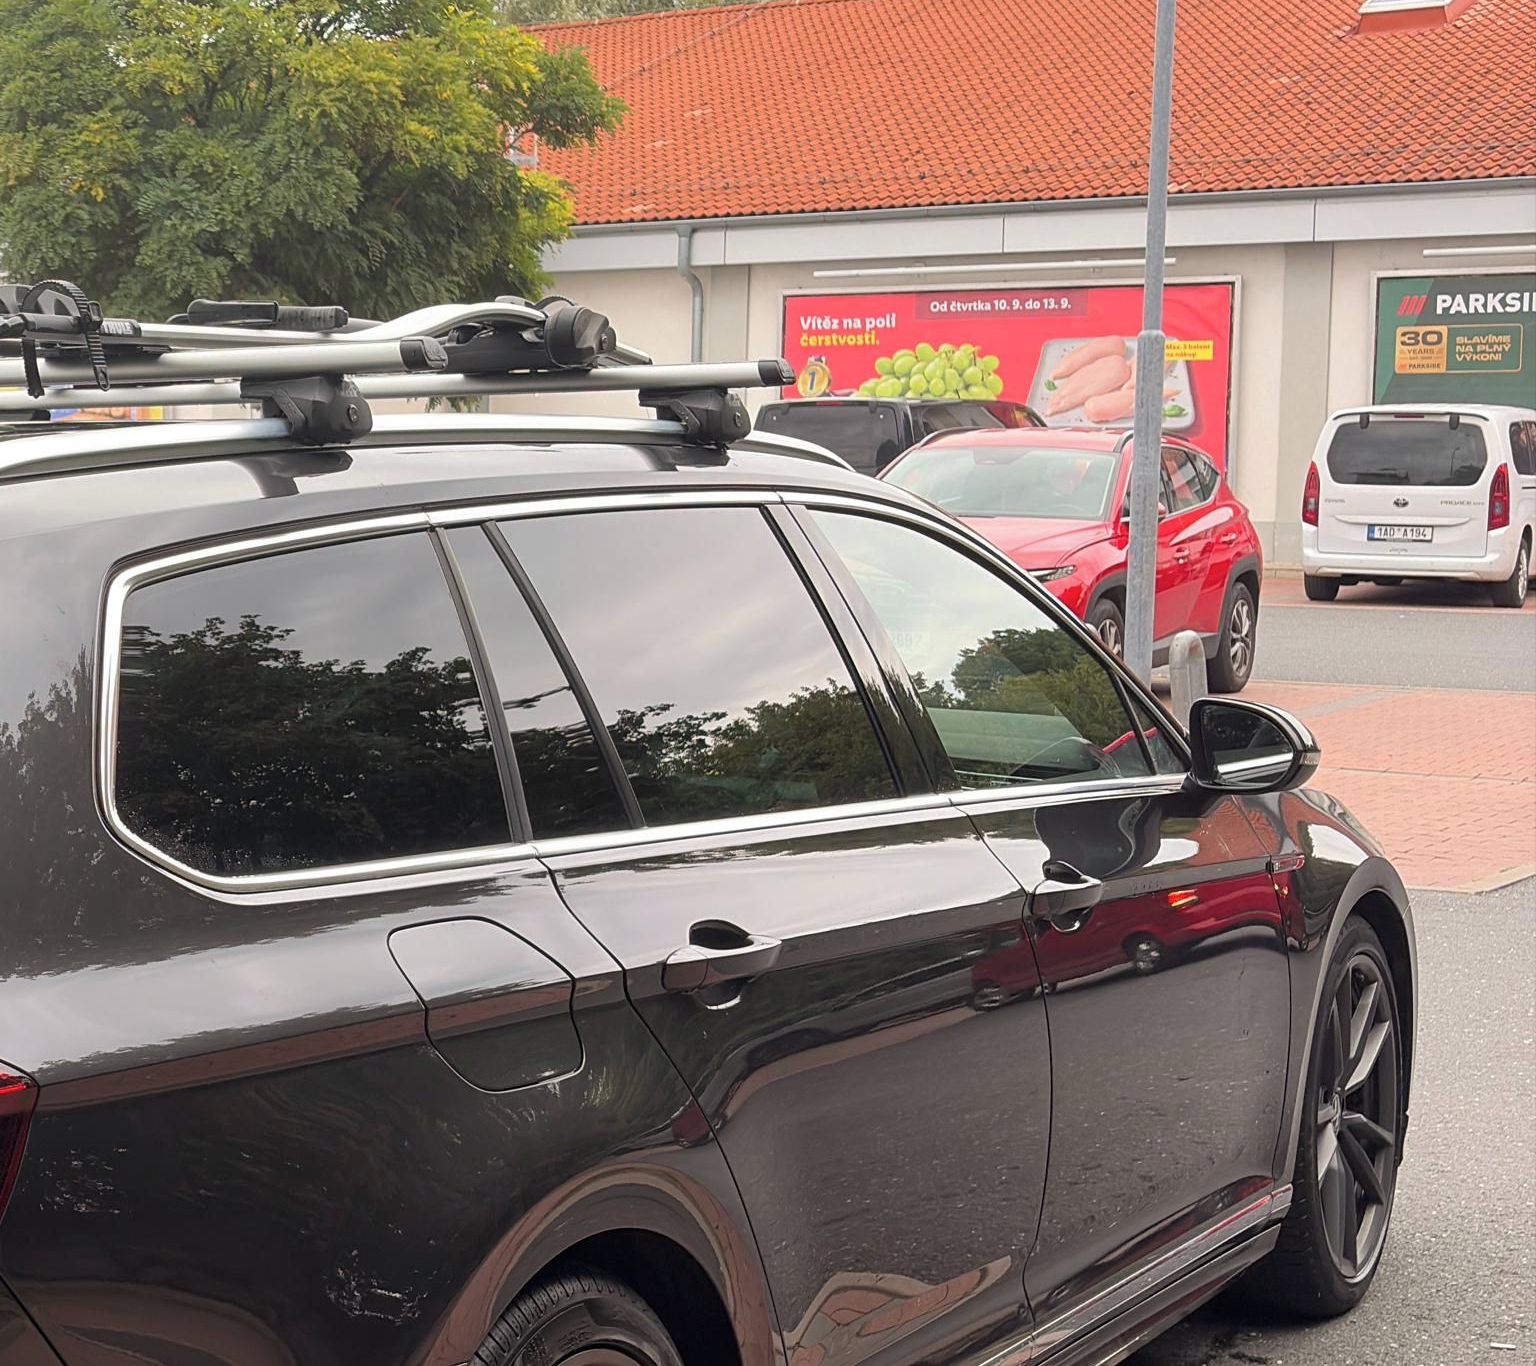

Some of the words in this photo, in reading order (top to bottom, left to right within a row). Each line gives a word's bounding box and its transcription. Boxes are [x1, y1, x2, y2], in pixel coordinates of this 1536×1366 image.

[930, 301, 948, 312] Od
[950, 299, 991, 312] čtvrtka
[993, 299, 1010, 311] 10.
[1012, 299, 1023, 310] 9.
[1025, 298, 1041, 310] do
[1043, 298, 1058, 309] 13.
[1061, 298, 1071, 309] 9.
[1436, 292, 1536, 315] PARKSI
[800, 315, 839, 330] Vítěz
[843, 318, 862, 329] na
[865, 313, 896, 331] poli
[800, 330, 880, 347] čerstvosti.
[1400, 331, 1443, 346] 30
[1456, 334, 1511, 344] SLAVÍME
[1456, 345, 1473, 353] NA
[1477, 343, 1511, 352] PLNÝ
